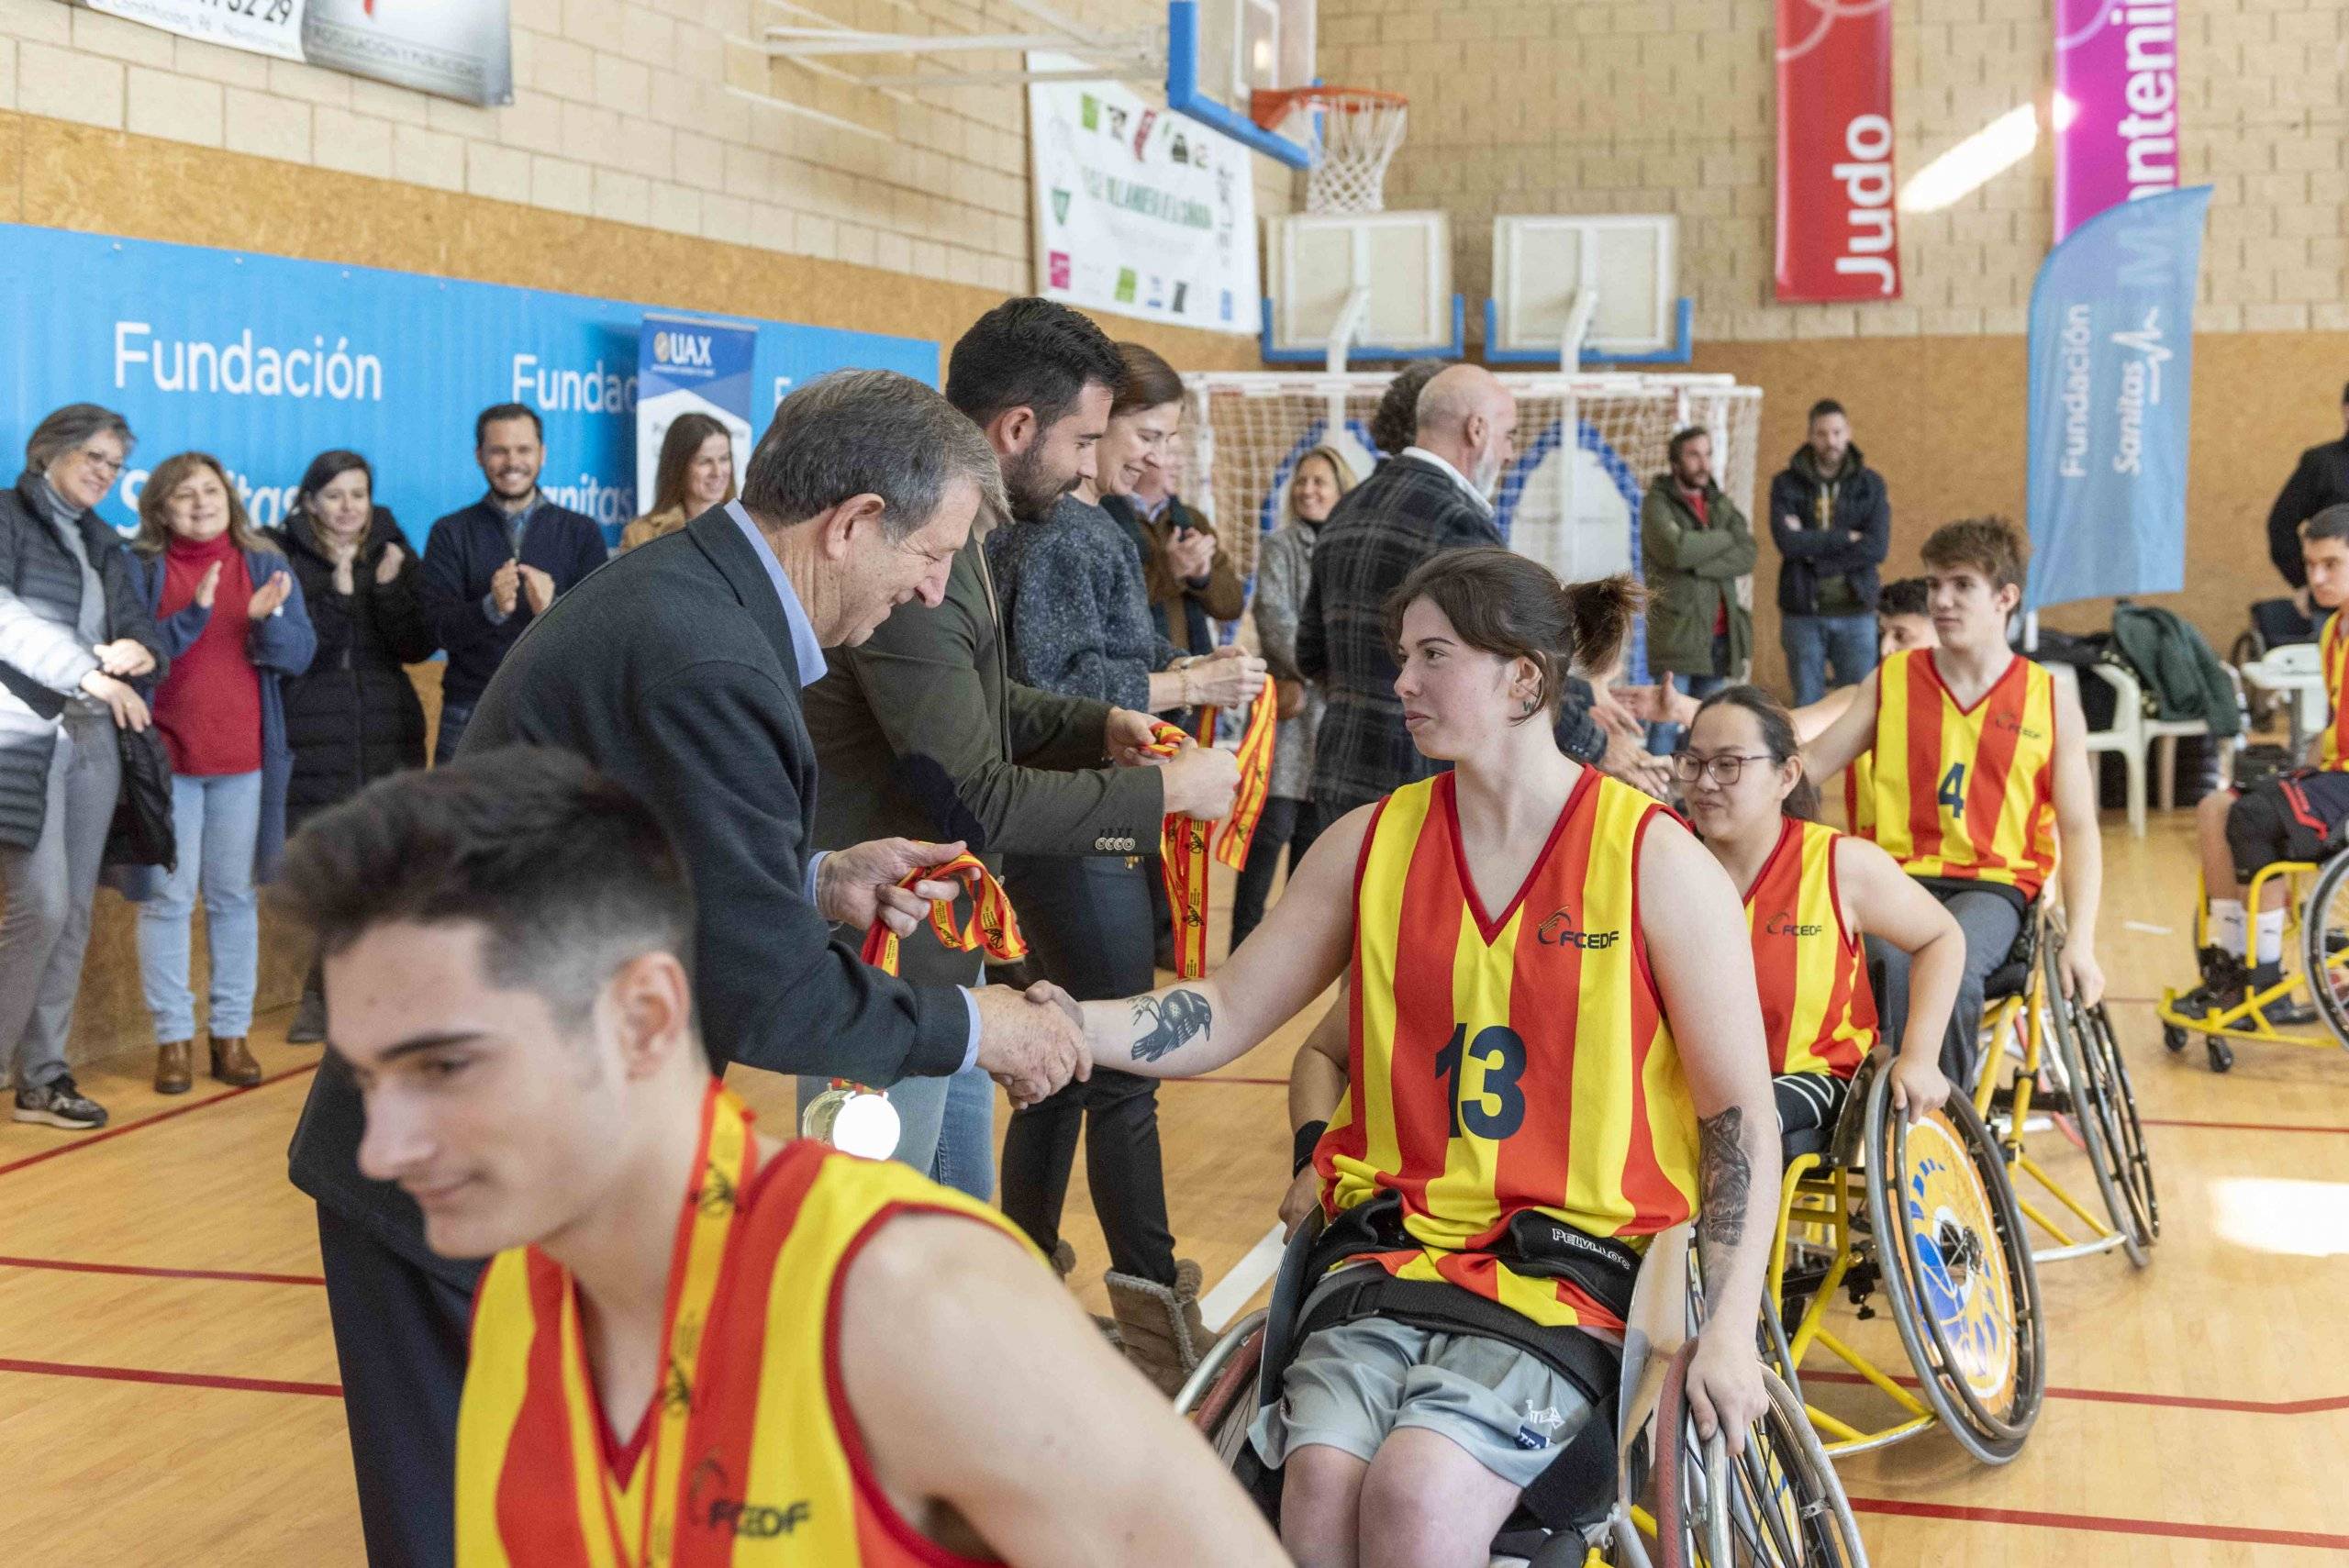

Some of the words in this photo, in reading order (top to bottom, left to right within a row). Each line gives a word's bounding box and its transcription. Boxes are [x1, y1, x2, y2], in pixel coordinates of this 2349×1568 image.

[1832, 114, 1894, 294] Judo
[115, 321, 382, 401] Fundación
[671, 332, 712, 366] UAX
[2061, 304, 2089, 476] Fundación
[2114, 361, 2144, 475] Sanitas
[1938, 762, 1966, 819] 4
[1559, 930, 1620, 950] FCEDF
[1782, 924, 1822, 937] FCEDF
[1434, 1022, 1528, 1141] 13
